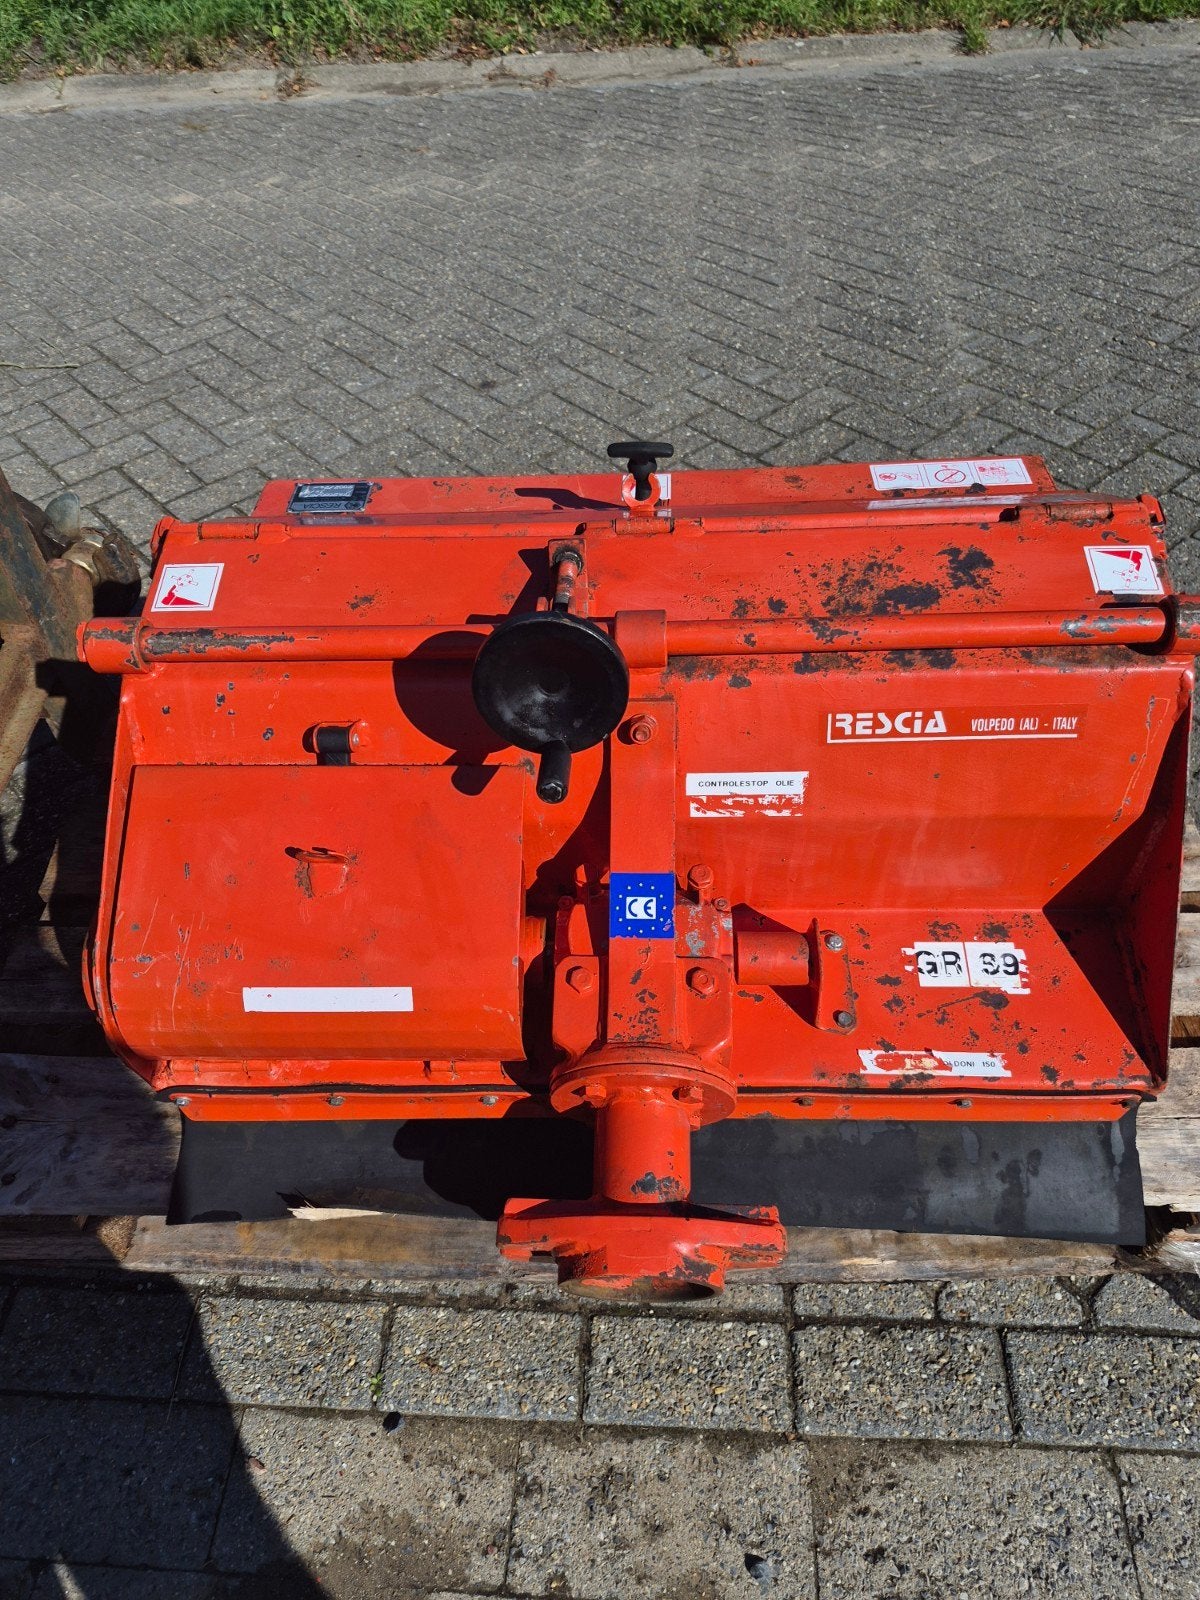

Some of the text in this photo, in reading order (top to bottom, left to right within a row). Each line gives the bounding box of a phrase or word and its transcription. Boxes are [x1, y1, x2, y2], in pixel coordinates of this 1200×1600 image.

[303, 502, 342, 510] RESCIA
[971, 717, 1014, 732] VOLPEDO
[1019, 717, 1039, 731] (AL)
[1052, 716, 1078, 730] ITALY
[698, 779, 795, 788] CONTROLESTOP OLIE
[627, 898, 654, 918] CE
